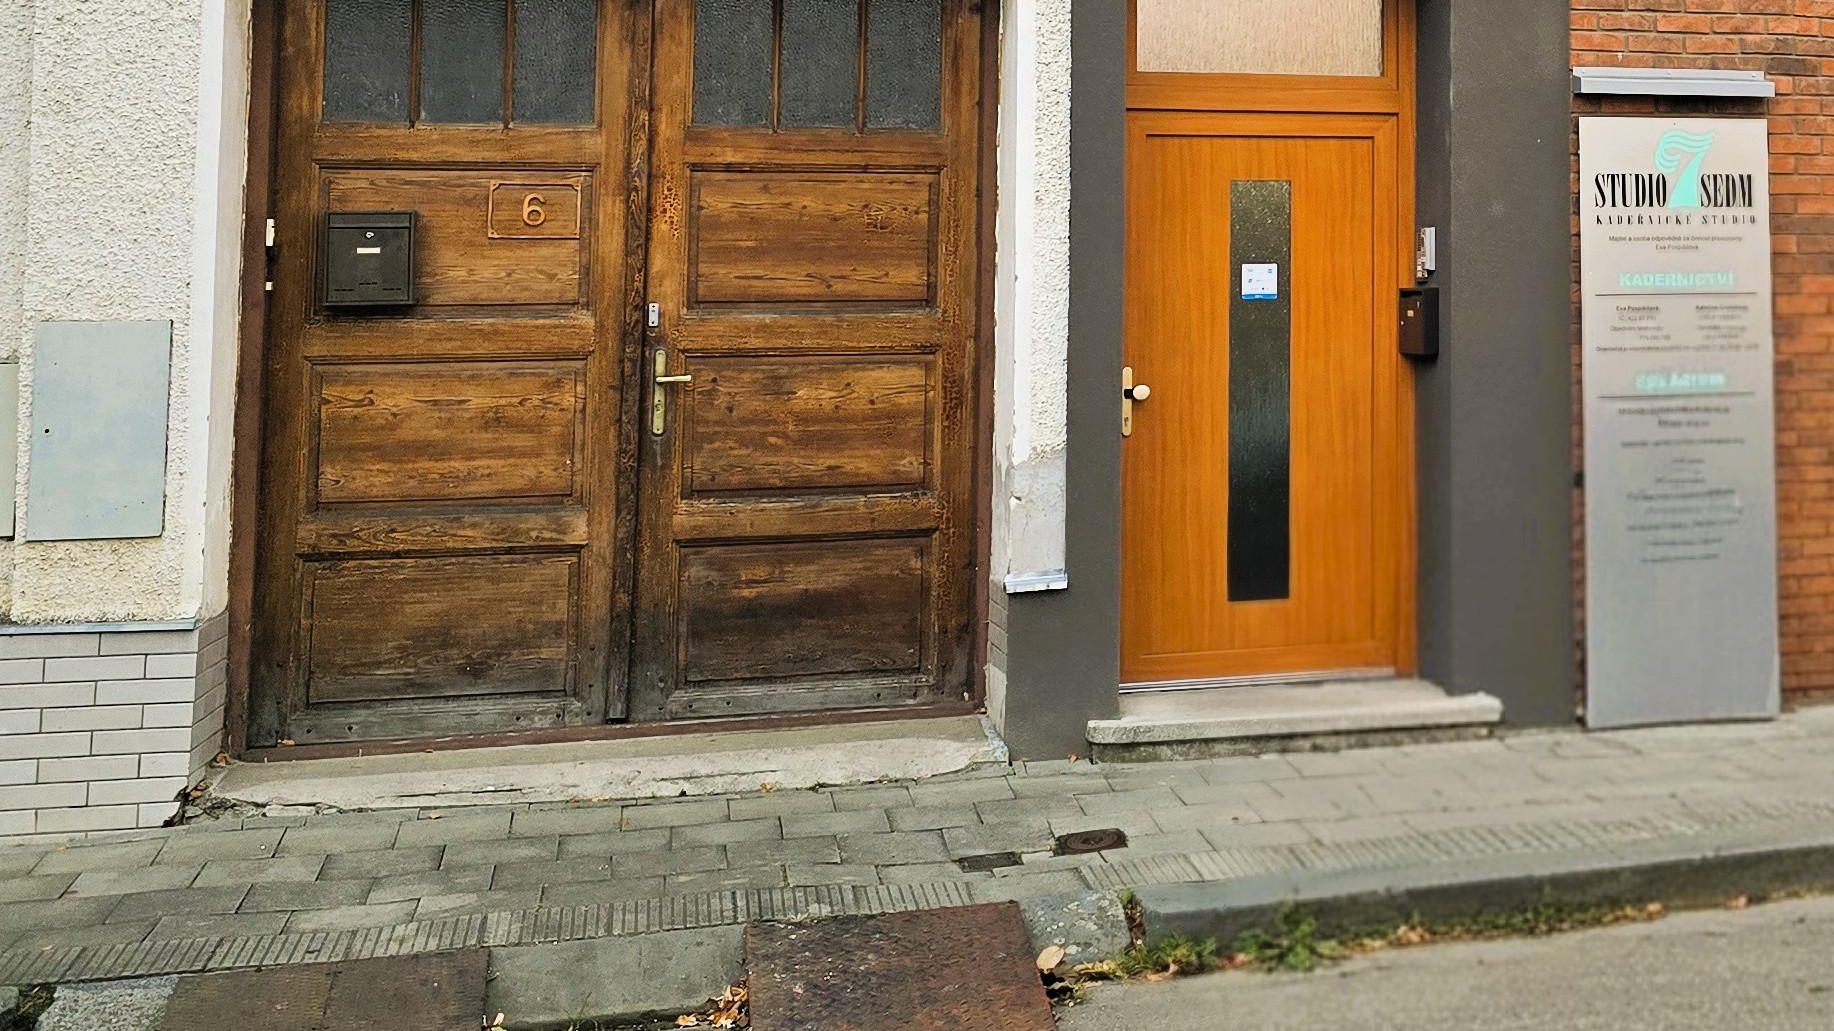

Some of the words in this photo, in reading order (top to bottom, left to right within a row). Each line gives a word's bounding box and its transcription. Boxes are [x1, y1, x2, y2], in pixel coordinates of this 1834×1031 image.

[1594, 172, 1667, 208] STUDIO
[1654, 128, 1715, 209] 7
[1700, 172, 1753, 208] SEDM
[522, 192, 546, 226] 6
[1596, 212, 1692, 225] KADEŘNICKÉ
[1702, 214, 1757, 225] STUDIO
[1619, 271, 1734, 287] KADEŘNICTVÍ
